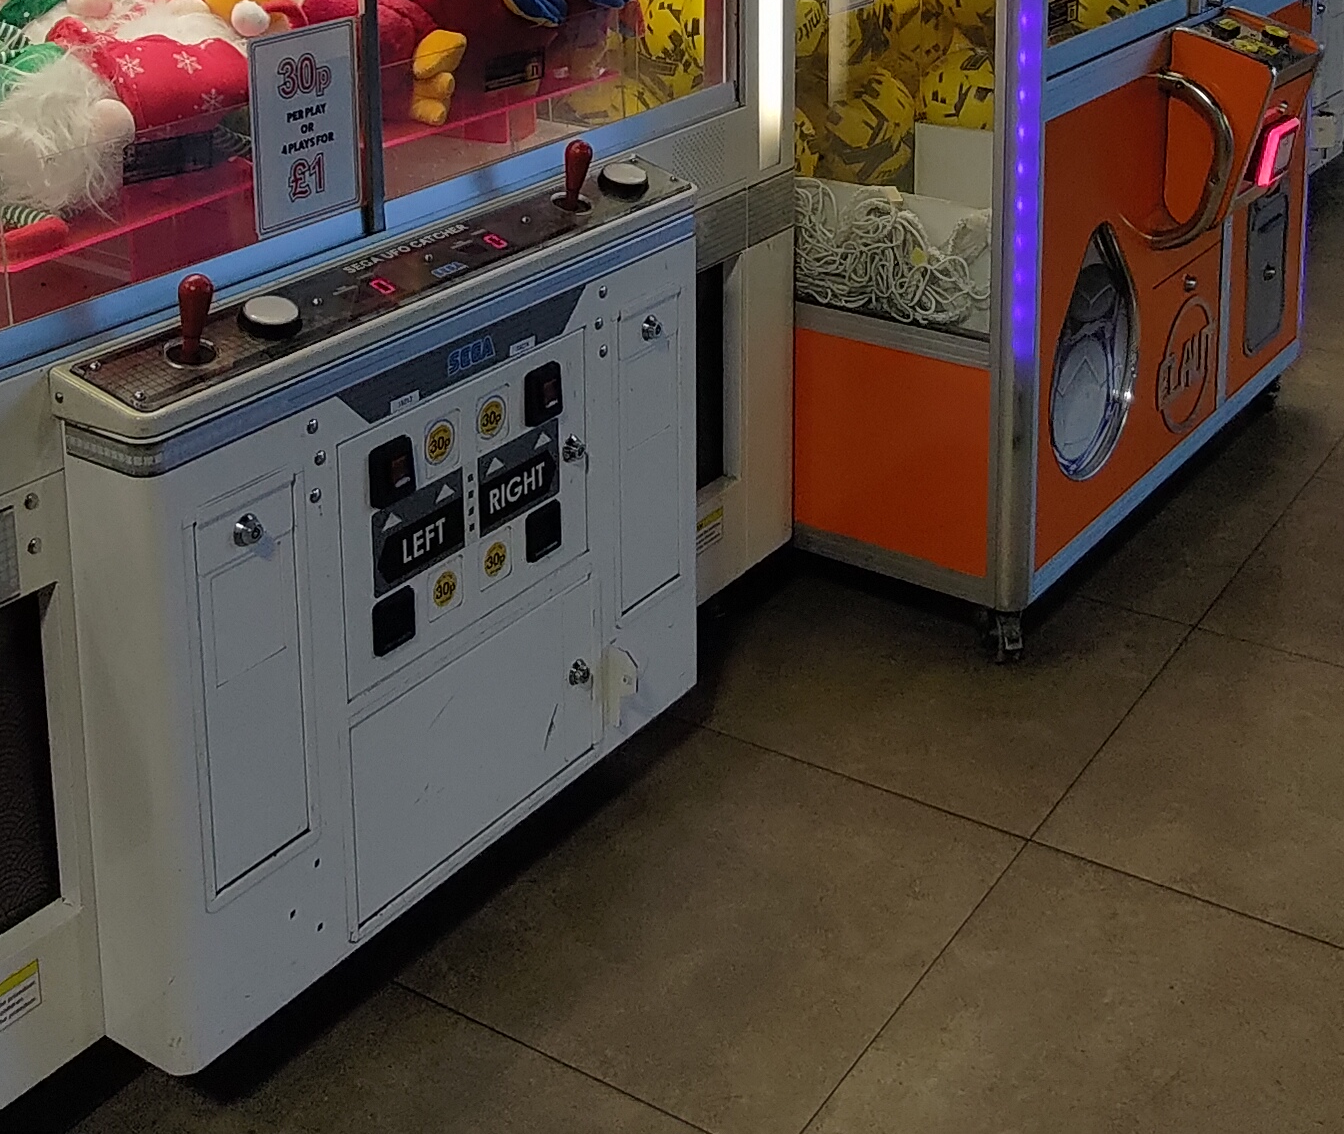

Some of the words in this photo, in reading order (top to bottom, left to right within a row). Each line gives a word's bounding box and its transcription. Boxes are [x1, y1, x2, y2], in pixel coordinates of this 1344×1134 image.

[277, 52, 332, 100] 30p
[286, 109, 304, 123] PER
[305, 102, 327, 118] PLAY
[300, 122, 314, 134] OR
[281, 145, 288, 155] 4
[288, 136, 315, 154] PLAYS
[316, 131, 335, 146] FOR
[289, 152, 326, 203] £1
[342, 256, 384, 275] SEGA
[383, 245, 411, 260] UFO
[410, 223, 470, 249] CATCHER
[447, 336, 495, 376] SEGA
[481, 410, 502, 428] 30p
[429, 436, 451, 454] 30p
[488, 462, 545, 514] RIGHT
[402, 517, 446, 564] LEFT
[484, 551, 505, 569] 30p
[435, 581, 456, 599] 30p
